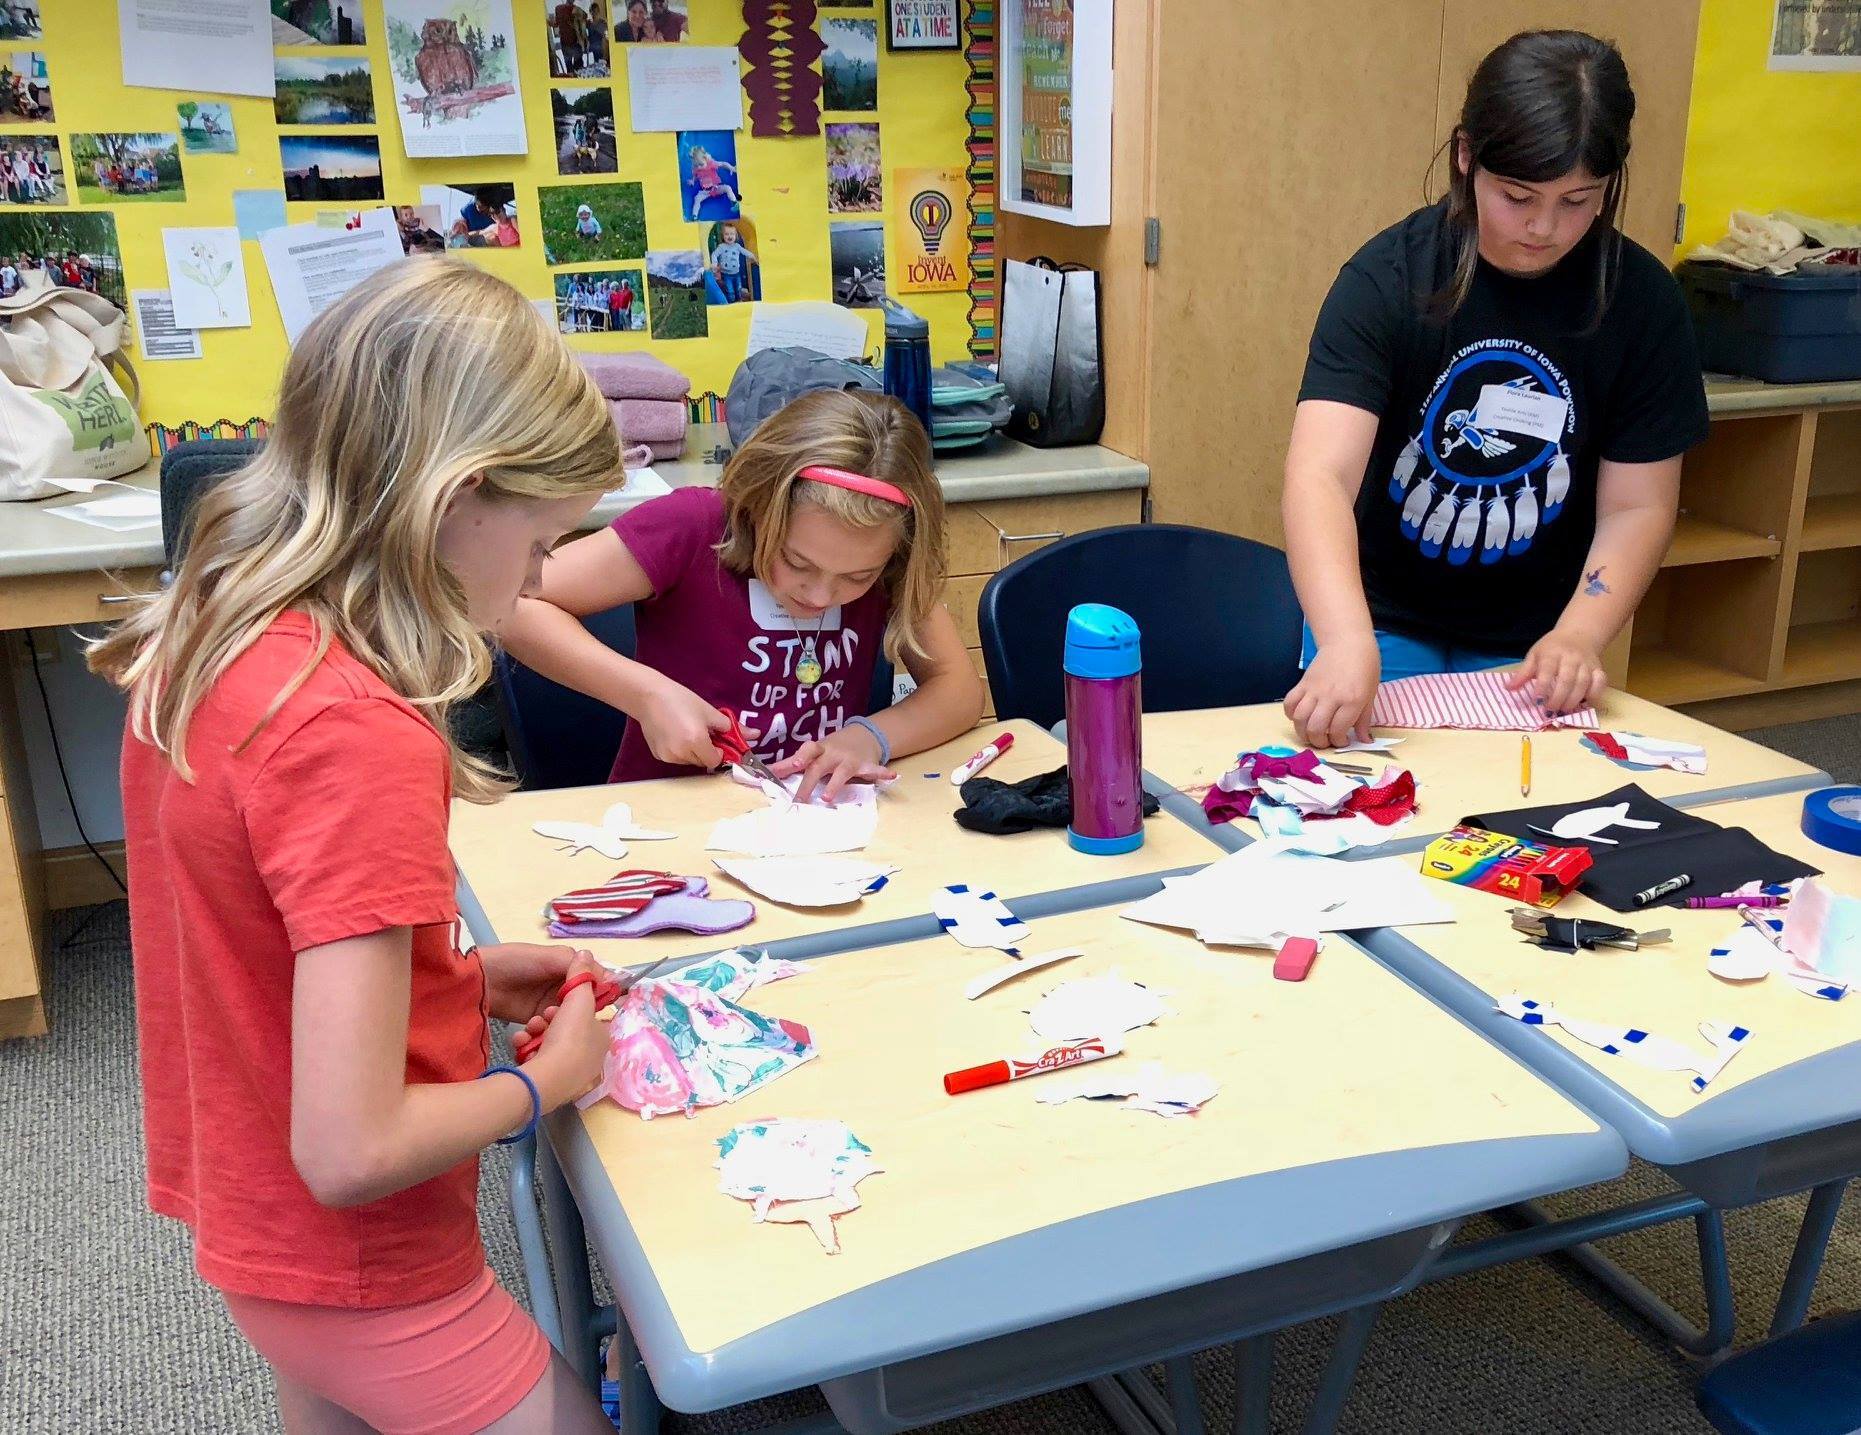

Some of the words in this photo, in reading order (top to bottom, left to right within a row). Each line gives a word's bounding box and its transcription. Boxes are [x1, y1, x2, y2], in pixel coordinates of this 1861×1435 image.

[895, 2, 912, 16] ONE
[913, 2, 951, 16] STUDENT
[896, 17, 911, 38] AT
[912, 17, 922, 38] A
[922, 16, 953, 38] TIME
[907, 263, 957, 283] IOWA
[1458, 338, 1524, 358] UNIVERSITY
[1523, 344, 1538, 357] OF
[1537, 353, 1560, 381] IOWA
[1558, 378, 1576, 433] POWWOW
[742, 628, 858, 678] STAND
[751, 682, 787, 709] UP
[796, 680, 844, 708] FOR
[739, 705, 844, 747] EACH
[1498, 873, 1520, 889] 24
